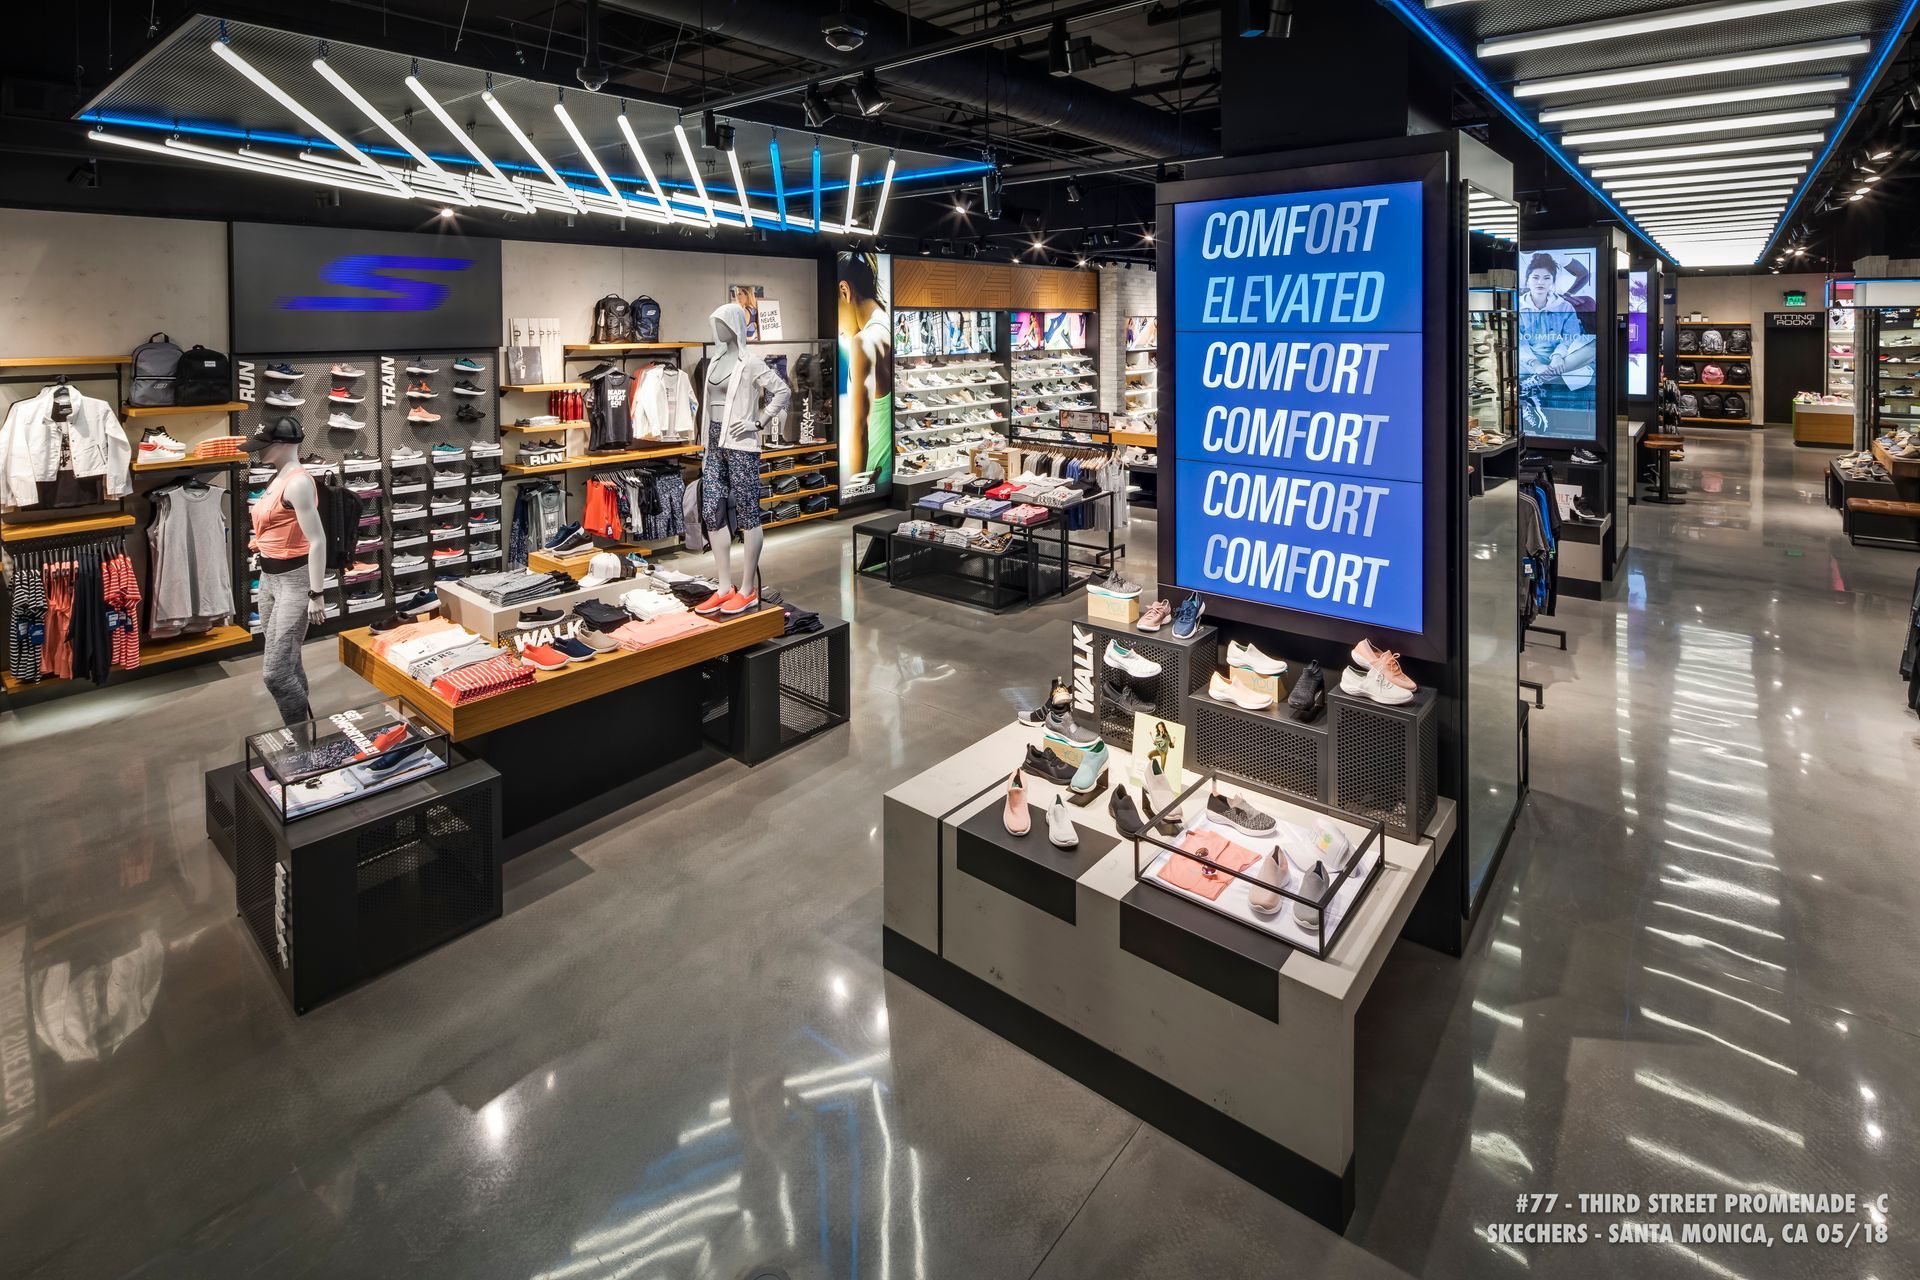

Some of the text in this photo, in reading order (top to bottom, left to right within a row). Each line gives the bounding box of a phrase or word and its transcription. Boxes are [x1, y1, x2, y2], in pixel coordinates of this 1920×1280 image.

[1202, 198, 1389, 260] COMFORT
[1202, 271, 1385, 323] ELEVATED
[1536, 333, 1590, 341] IMITATION
[238, 361, 255, 402] RUN
[381, 356, 396, 406] TRAIN
[1202, 341, 1389, 395] COMFORT
[771, 416, 779, 446] LEGG
[1202, 405, 1389, 465] COMFORT
[530, 452, 563, 466] RUN
[1202, 470, 1389, 537] COMFORT
[1202, 533, 1389, 608] COMFORT
[1107, 600, 1127, 614] YOU
[514, 619, 584, 652] WALK
[1072, 624, 1095, 714] WALK
[1251, 676, 1275, 691] YOU
[329, 713, 382, 756] COMFORTABLE!
[342, 709, 364, 721] GET
